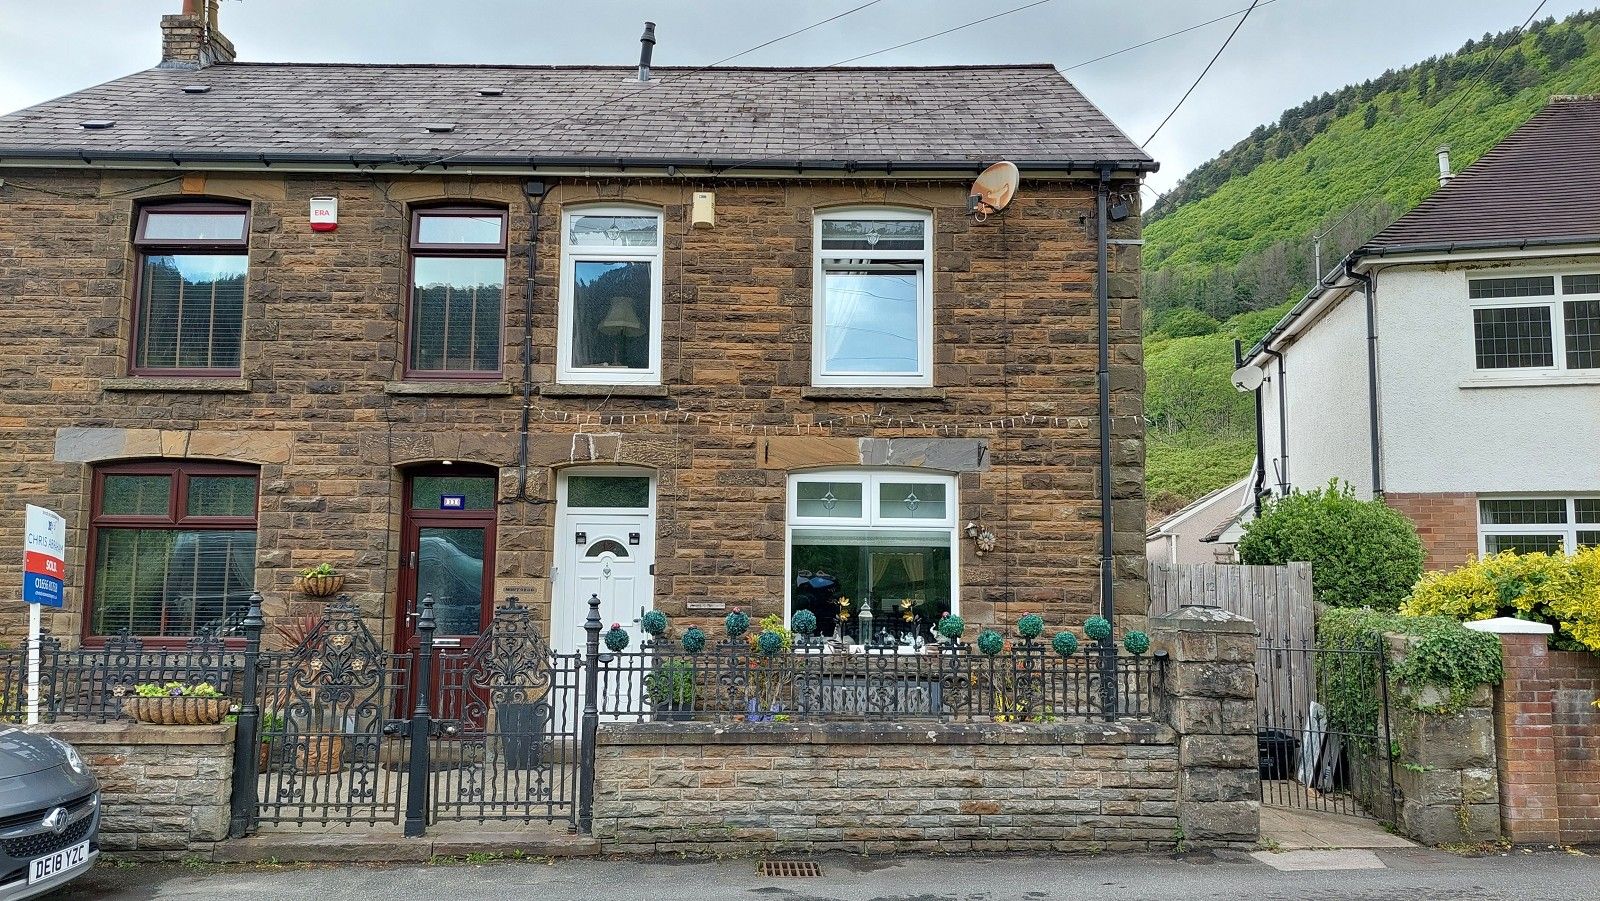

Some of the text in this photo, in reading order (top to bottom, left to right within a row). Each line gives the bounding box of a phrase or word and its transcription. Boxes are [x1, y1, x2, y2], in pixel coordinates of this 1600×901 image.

[28, 533, 47, 547] CHRIS
[1205, 582, 1215, 591] 12
[36, 845, 84, 879] DE18 YZC
